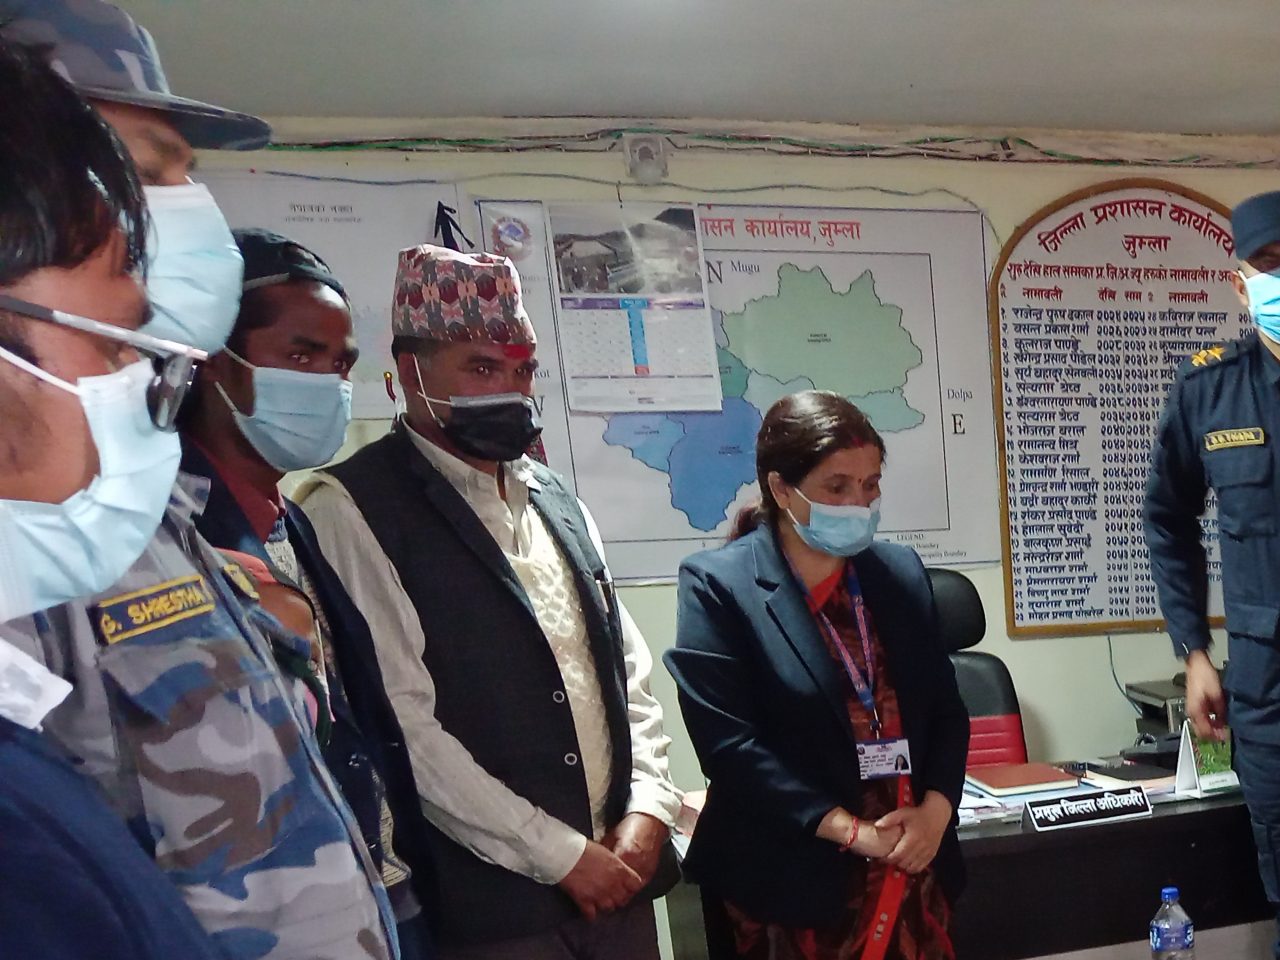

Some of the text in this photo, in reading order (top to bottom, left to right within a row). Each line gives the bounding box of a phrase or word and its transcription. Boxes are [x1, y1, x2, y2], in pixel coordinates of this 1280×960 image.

[818, 221, 861, 247] जुम्ला
[1038, 199, 1235, 258] जिल्ला प्रशासन कार्यालय
[1122, 234, 1171, 258] जुम्ला
[706, 261, 723, 284] N
[731, 261, 760, 275] Mugu
[1023, 260, 1041, 278] देखि
[1043, 264, 1061, 279] हाल
[1170, 266, 1208, 283] नामावली
[1210, 270, 1216, 283] र
[1023, 286, 1063, 301] नामावली
[1169, 290, 1208, 304] नामावली
[1012, 305, 1044, 321] राजेन्द्र
[1044, 324, 1070, 337] प्रकाश
[1072, 321, 1089, 335] शर्मा
[1159, 324, 1192, 338] दामोदर
[1196, 326, 1217, 338] पन्त
[1015, 338, 1051, 351] कुलराज
[1043, 353, 1067, 365] प्रसाद
[1014, 366, 1062, 382] सूर्य बहादुर
[947, 388, 973, 402] Dolpa
[1060, 380, 1081, 394] श्रेष्ठ
[1059, 408, 1080, 422] श्रेष्ठ
[952, 413, 965, 434] E
[1017, 423, 1055, 436] भोजराज
[1059, 426, 1086, 437] बराल
[1068, 563, 1088, 573] शर्मा
[1078, 573, 1098, 583] शर्मा
[1071, 586, 1090, 595] शर्मा
[127, 585, 205, 625] SHRESTHA
[1065, 597, 1085, 607] शर्मा
[1032, 790, 1144, 822] प्रमुख जिल्ला अधिकारी
